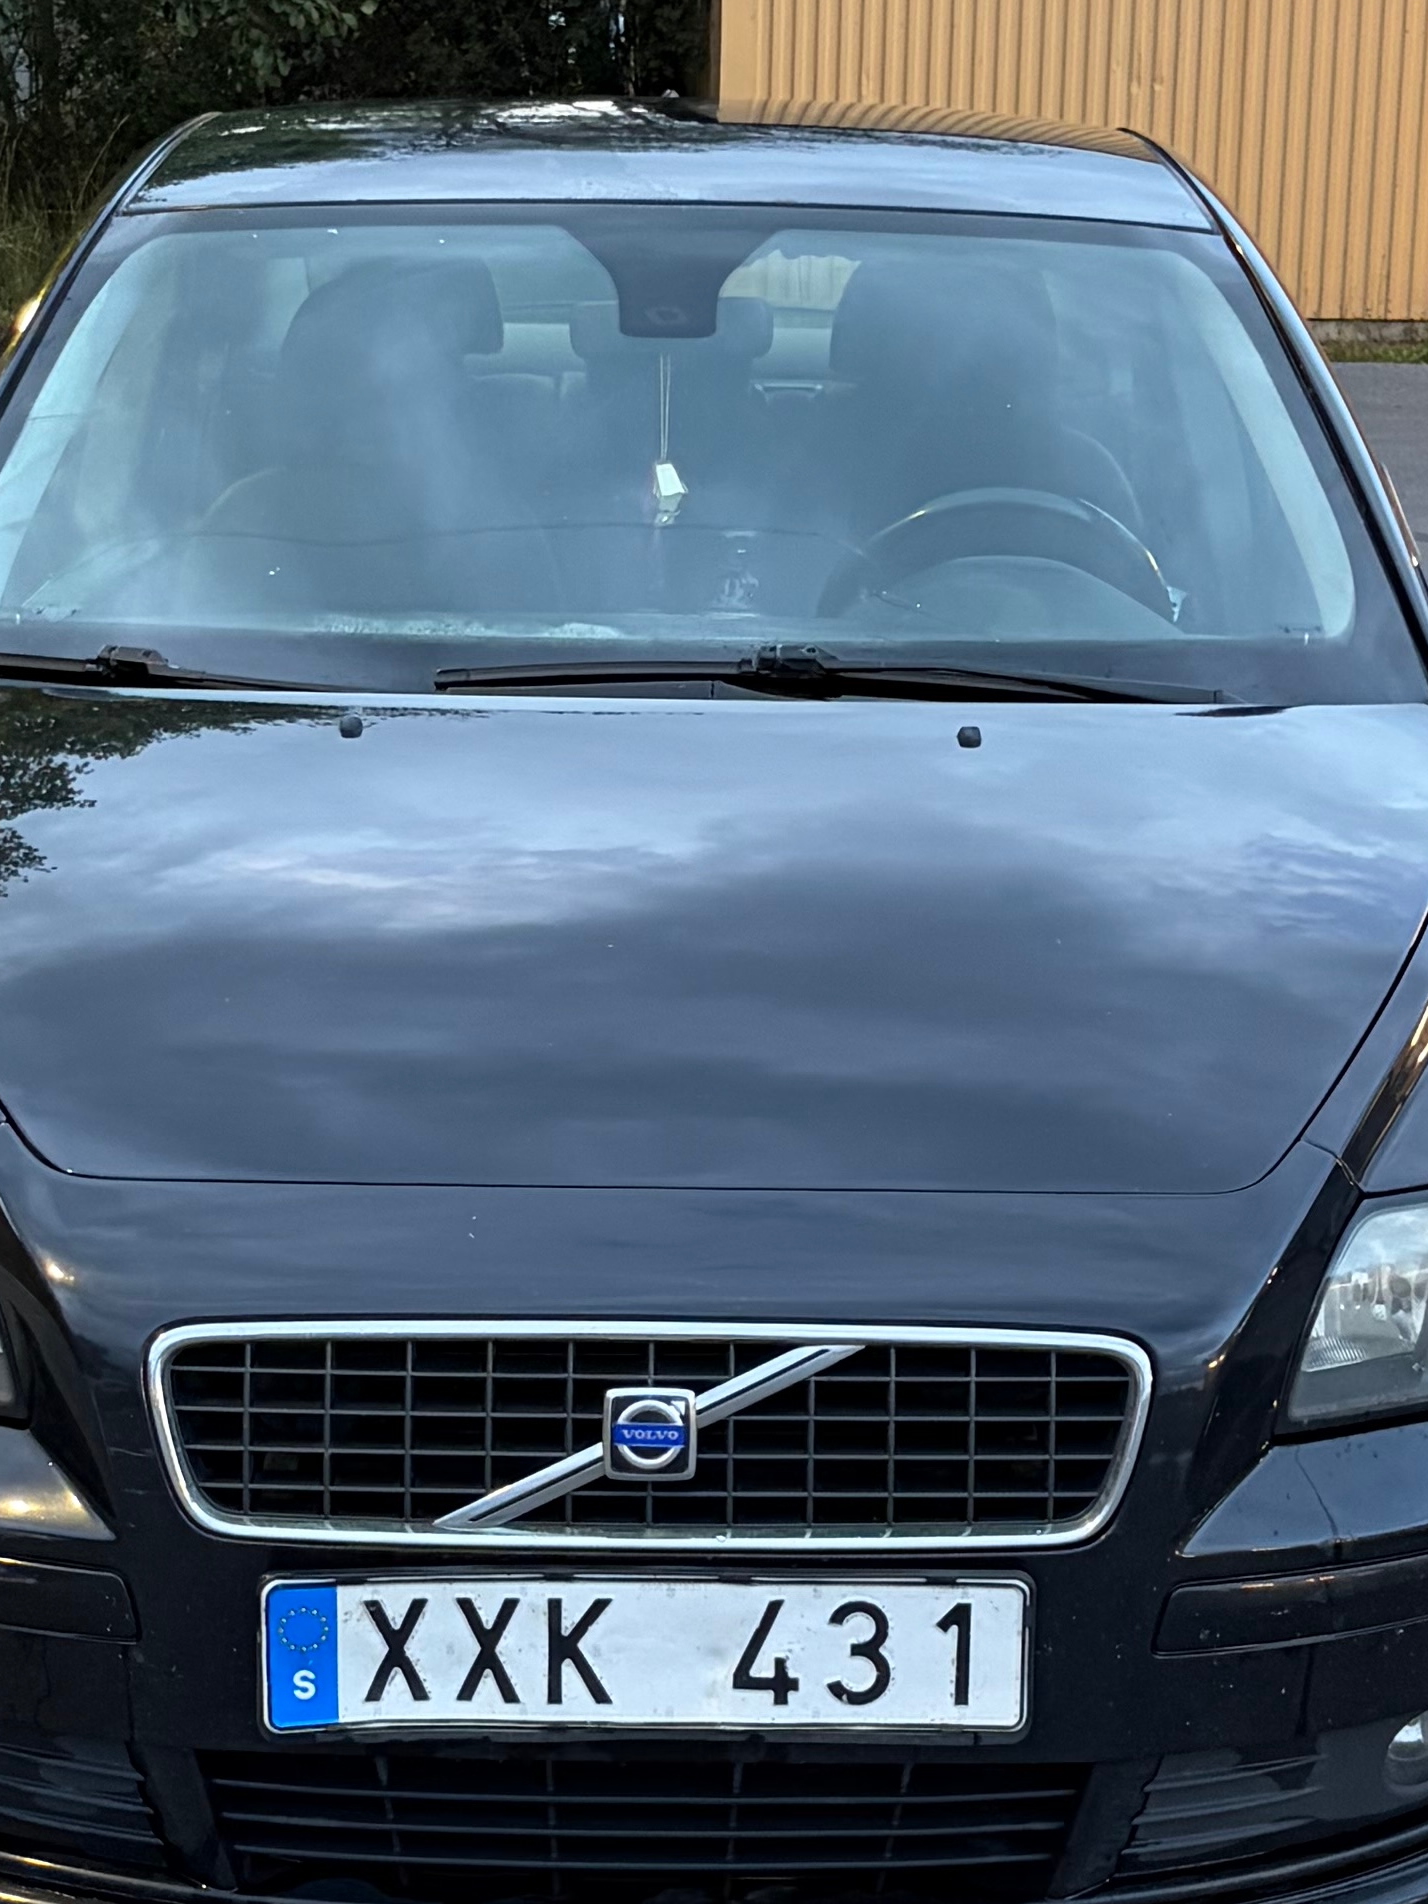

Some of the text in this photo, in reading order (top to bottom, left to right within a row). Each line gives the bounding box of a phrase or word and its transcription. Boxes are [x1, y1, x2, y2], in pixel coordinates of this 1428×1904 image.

[622, 1429, 679, 1440] VOLVO
[362, 1597, 975, 1706] XXK 431
[293, 1669, 317, 1701] S
